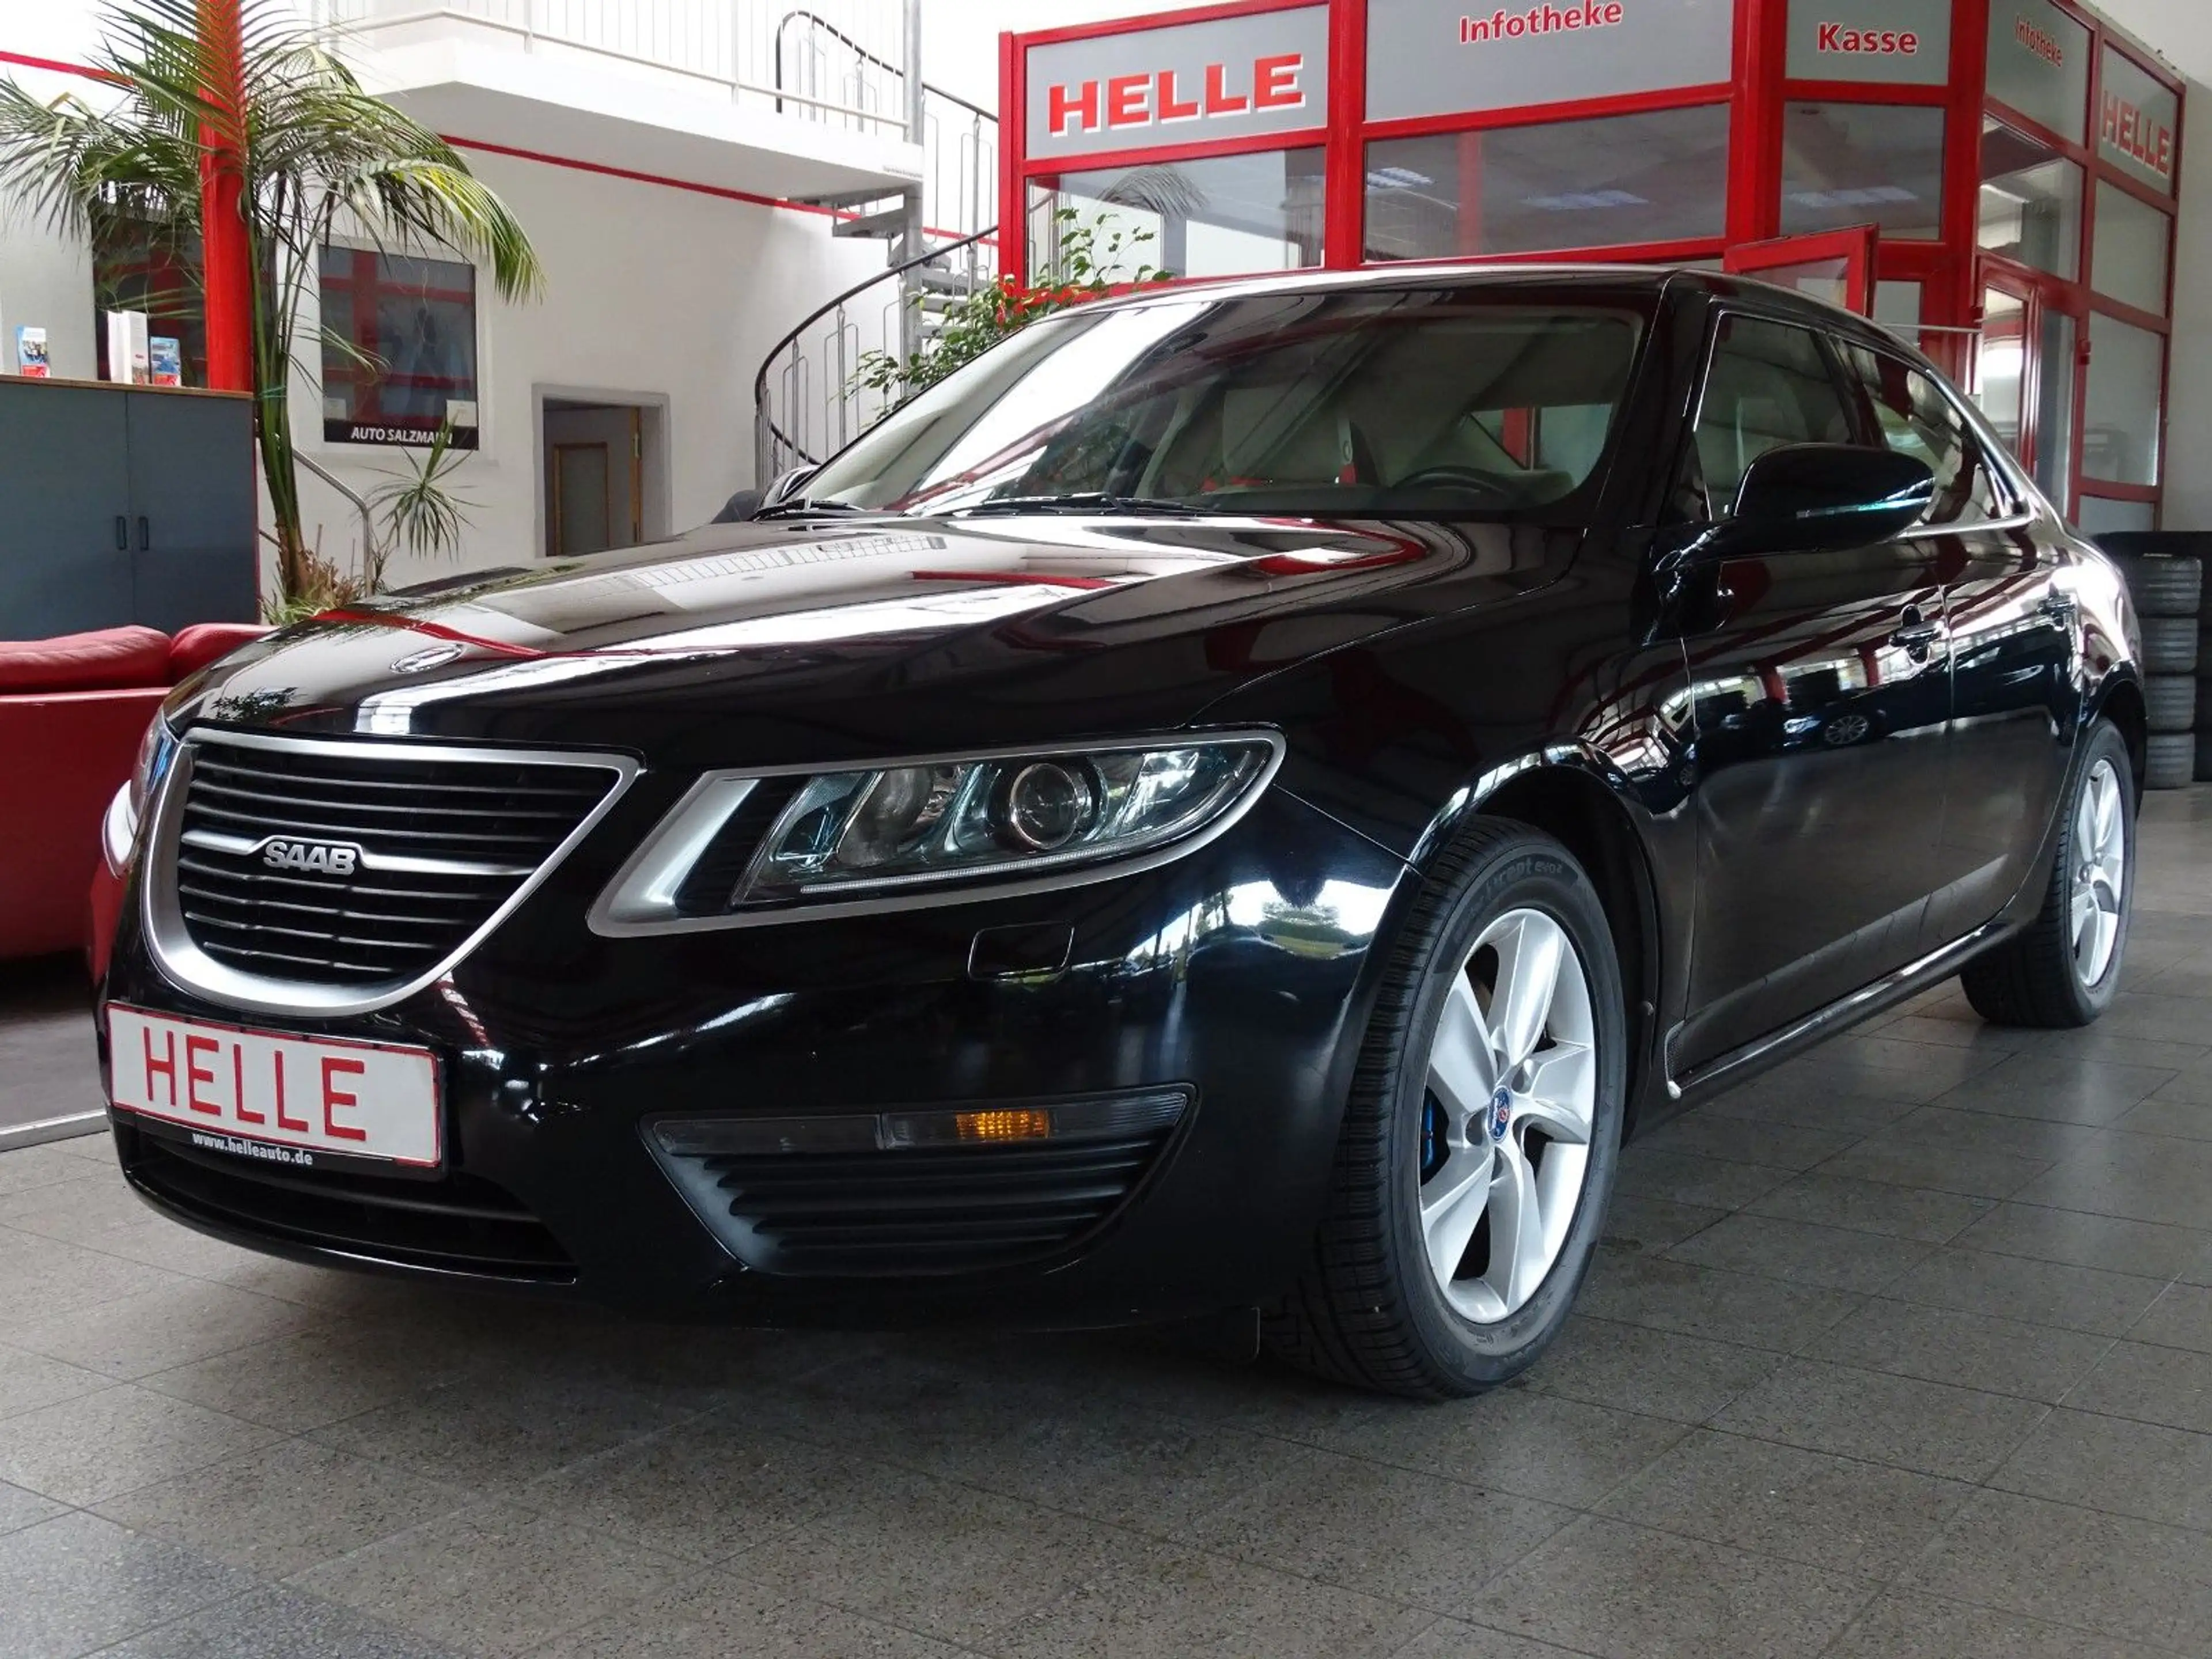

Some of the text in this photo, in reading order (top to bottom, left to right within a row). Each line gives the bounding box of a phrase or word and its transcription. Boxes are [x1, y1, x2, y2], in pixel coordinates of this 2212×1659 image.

[1459, 0, 1624, 44] Infotheke
[1817, 22, 1919, 55] Kasse
[2015, 13, 2063, 68] Infotheke
[1048, 53, 1305, 138] HELLE
[2102, 89, 2171, 175] HELLE
[351, 426, 385, 441] AUTO
[263, 841, 357, 875] SAAB
[143, 1026, 367, 1142] HELLE
[192, 1132, 313, 1165] www.helleauto.de
